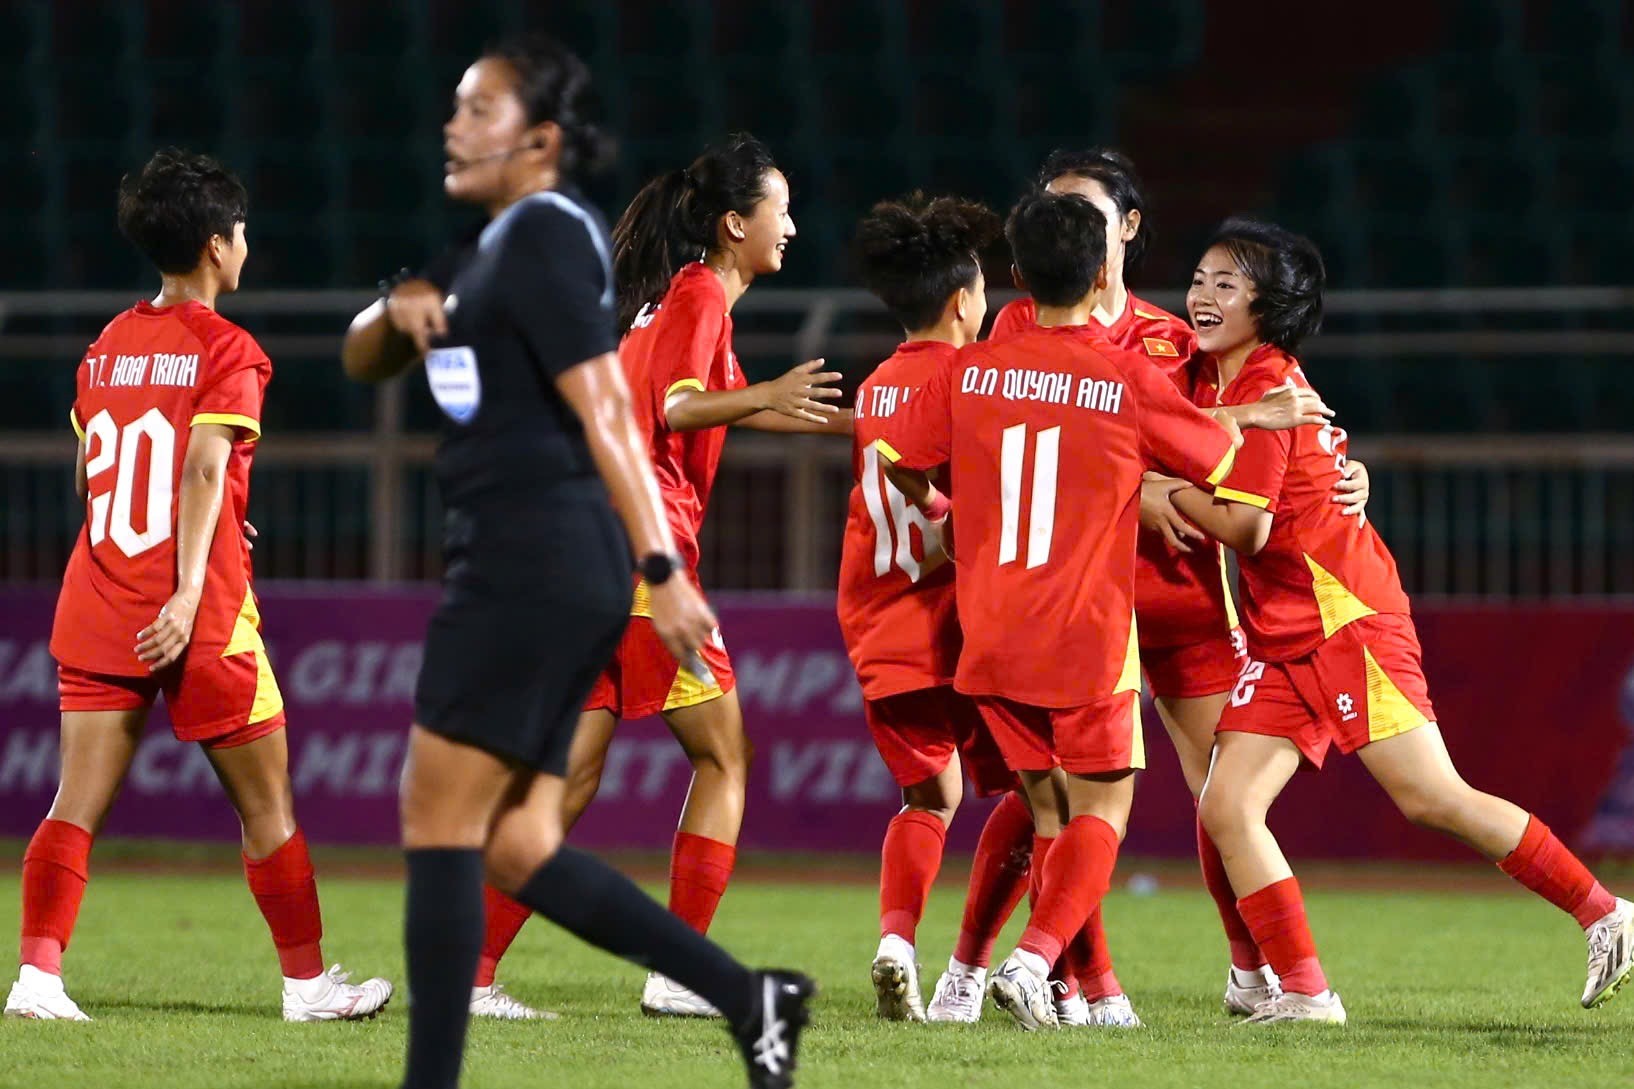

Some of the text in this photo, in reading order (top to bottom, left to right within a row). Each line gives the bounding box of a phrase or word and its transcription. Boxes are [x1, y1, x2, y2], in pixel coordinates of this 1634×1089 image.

[109, 354, 150, 388] HOAI
[150, 353, 199, 388] TRINH
[1002, 368, 1072, 405] QUYNH
[1076, 377, 1124, 414] ANH
[86, 407, 176, 559] 20
[861, 438, 940, 584] 16
[998, 422, 1061, 570] 11
